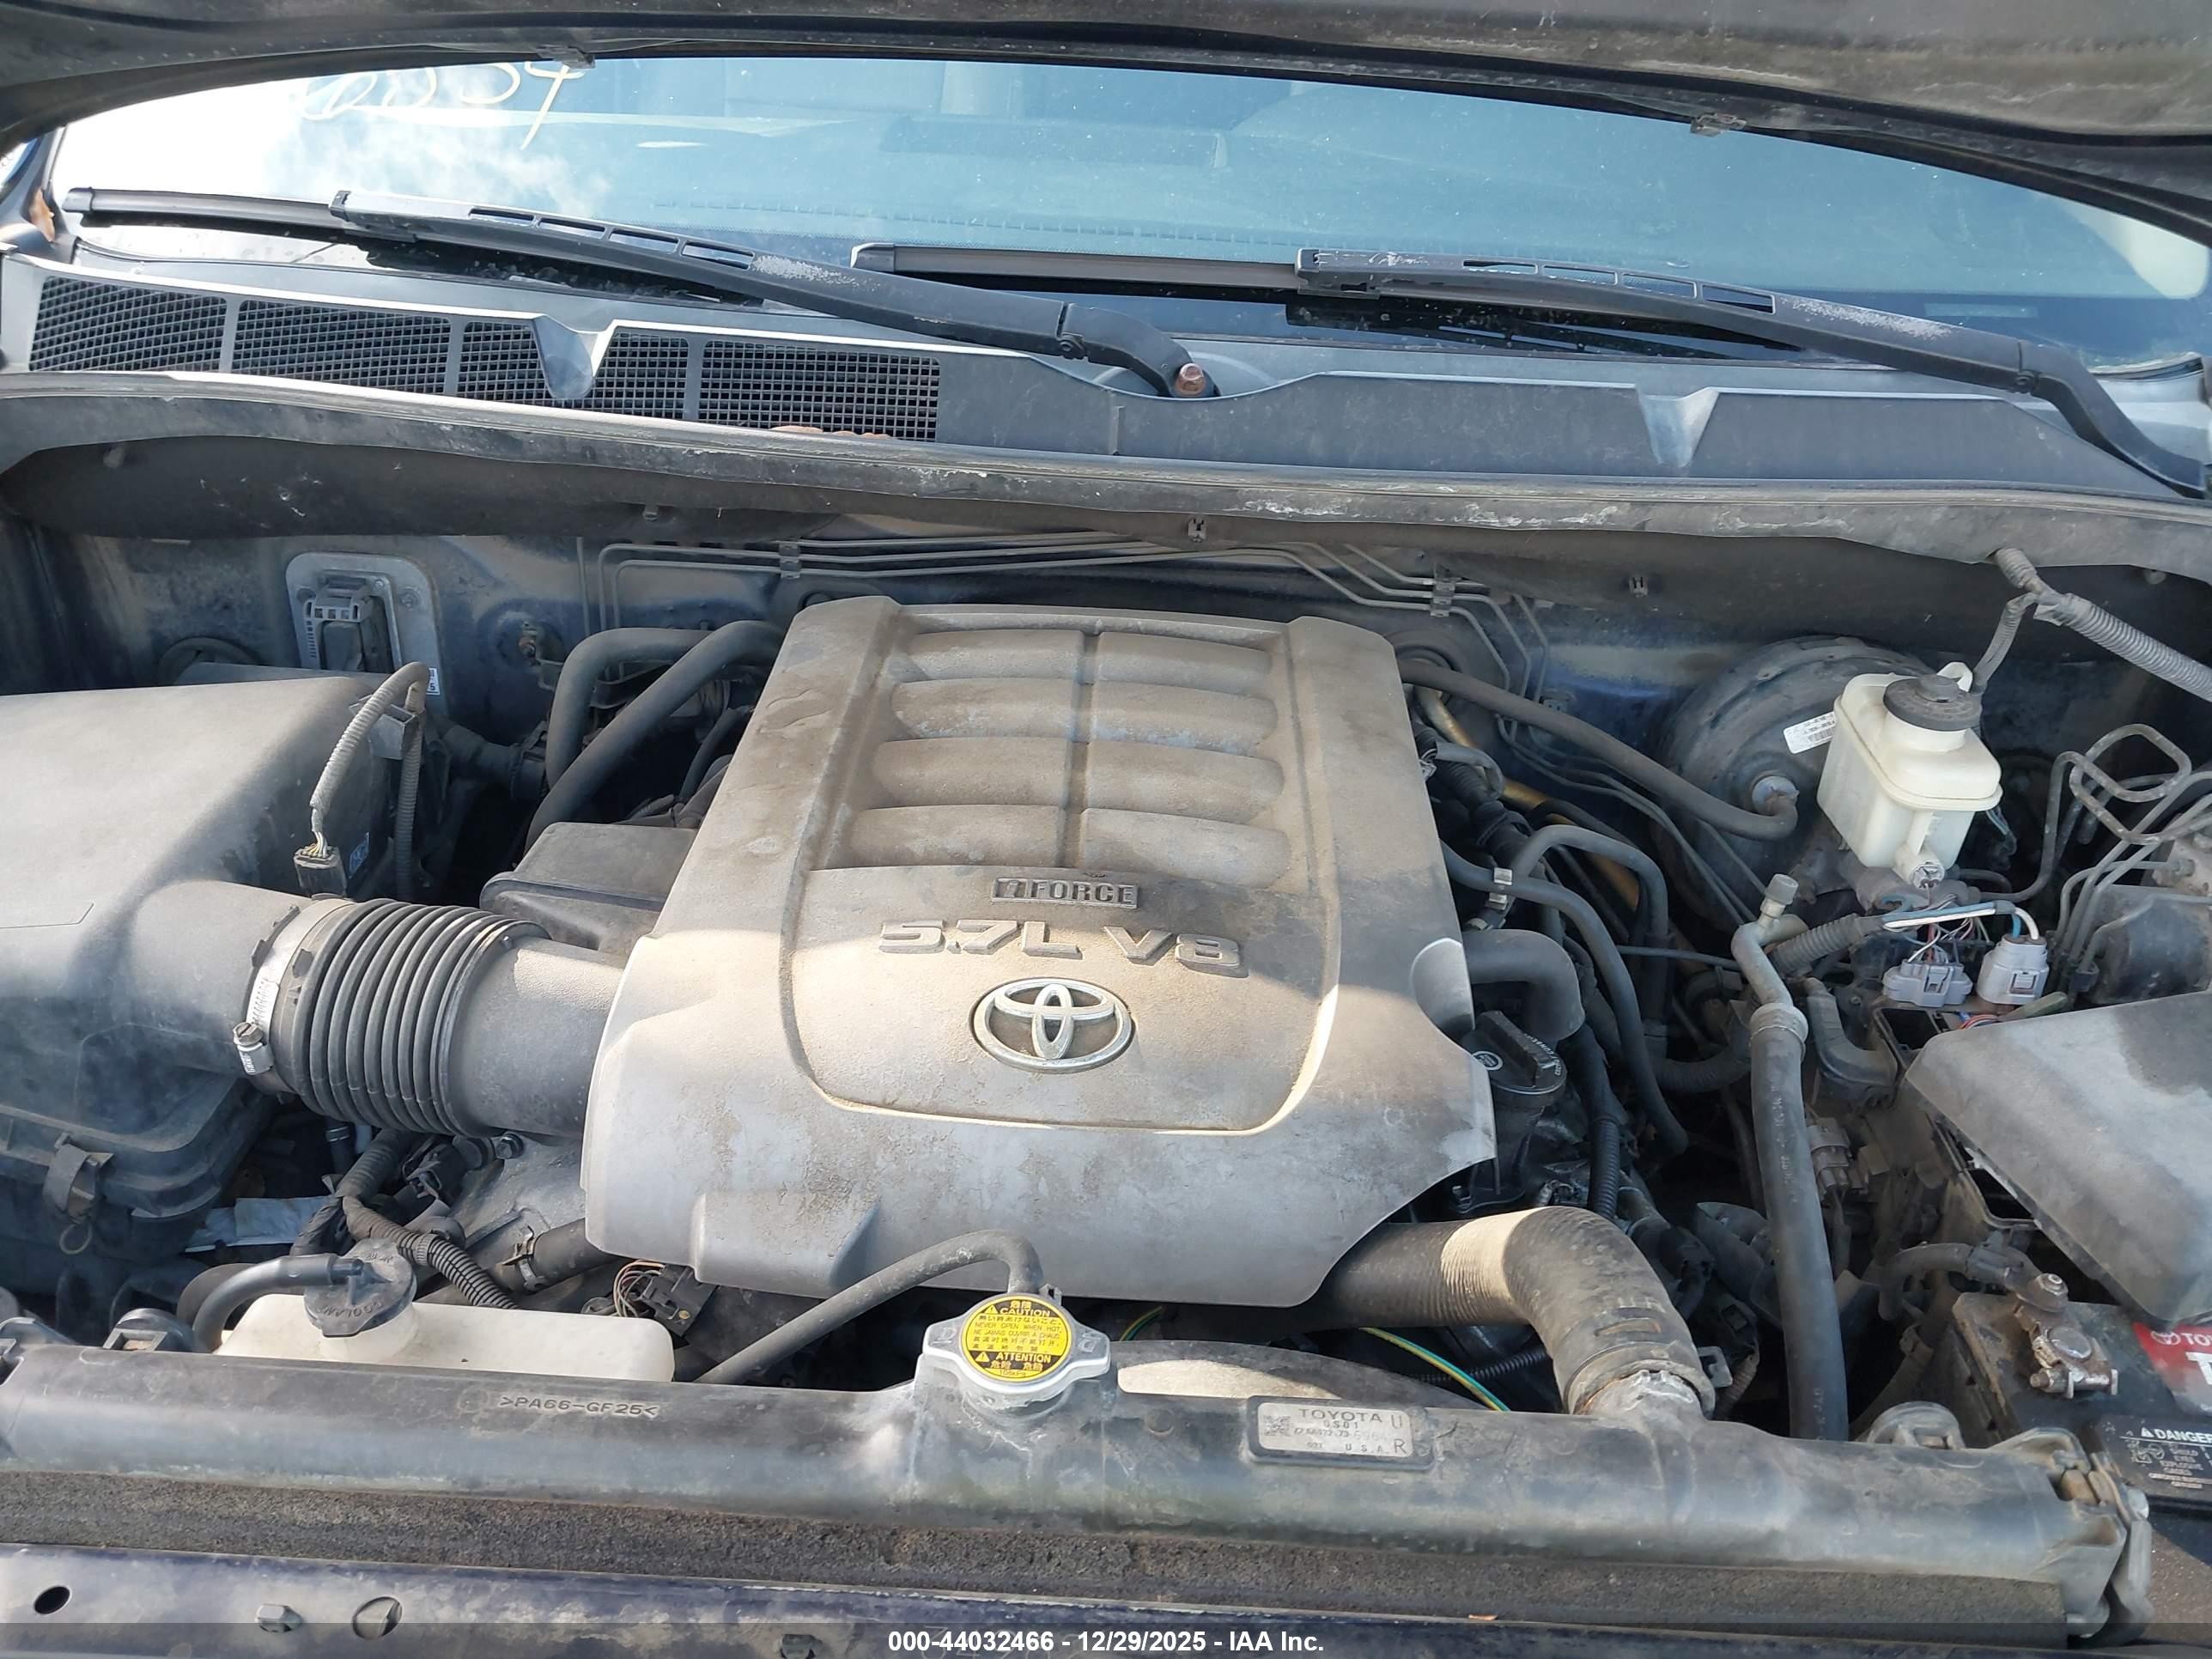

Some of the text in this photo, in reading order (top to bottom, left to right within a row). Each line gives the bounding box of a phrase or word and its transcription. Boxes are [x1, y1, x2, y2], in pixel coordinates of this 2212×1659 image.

[1030, 881, 1135, 905] FORCE
[878, 919, 1249, 979] 5.7L V8
[1000, 1307, 1051, 1317] CAUTION
[996, 1352, 1052, 1364] ATTENTION
[1298, 1408, 1403, 1429] TOYOTA U
[1394, 1438, 1407, 1455] R
